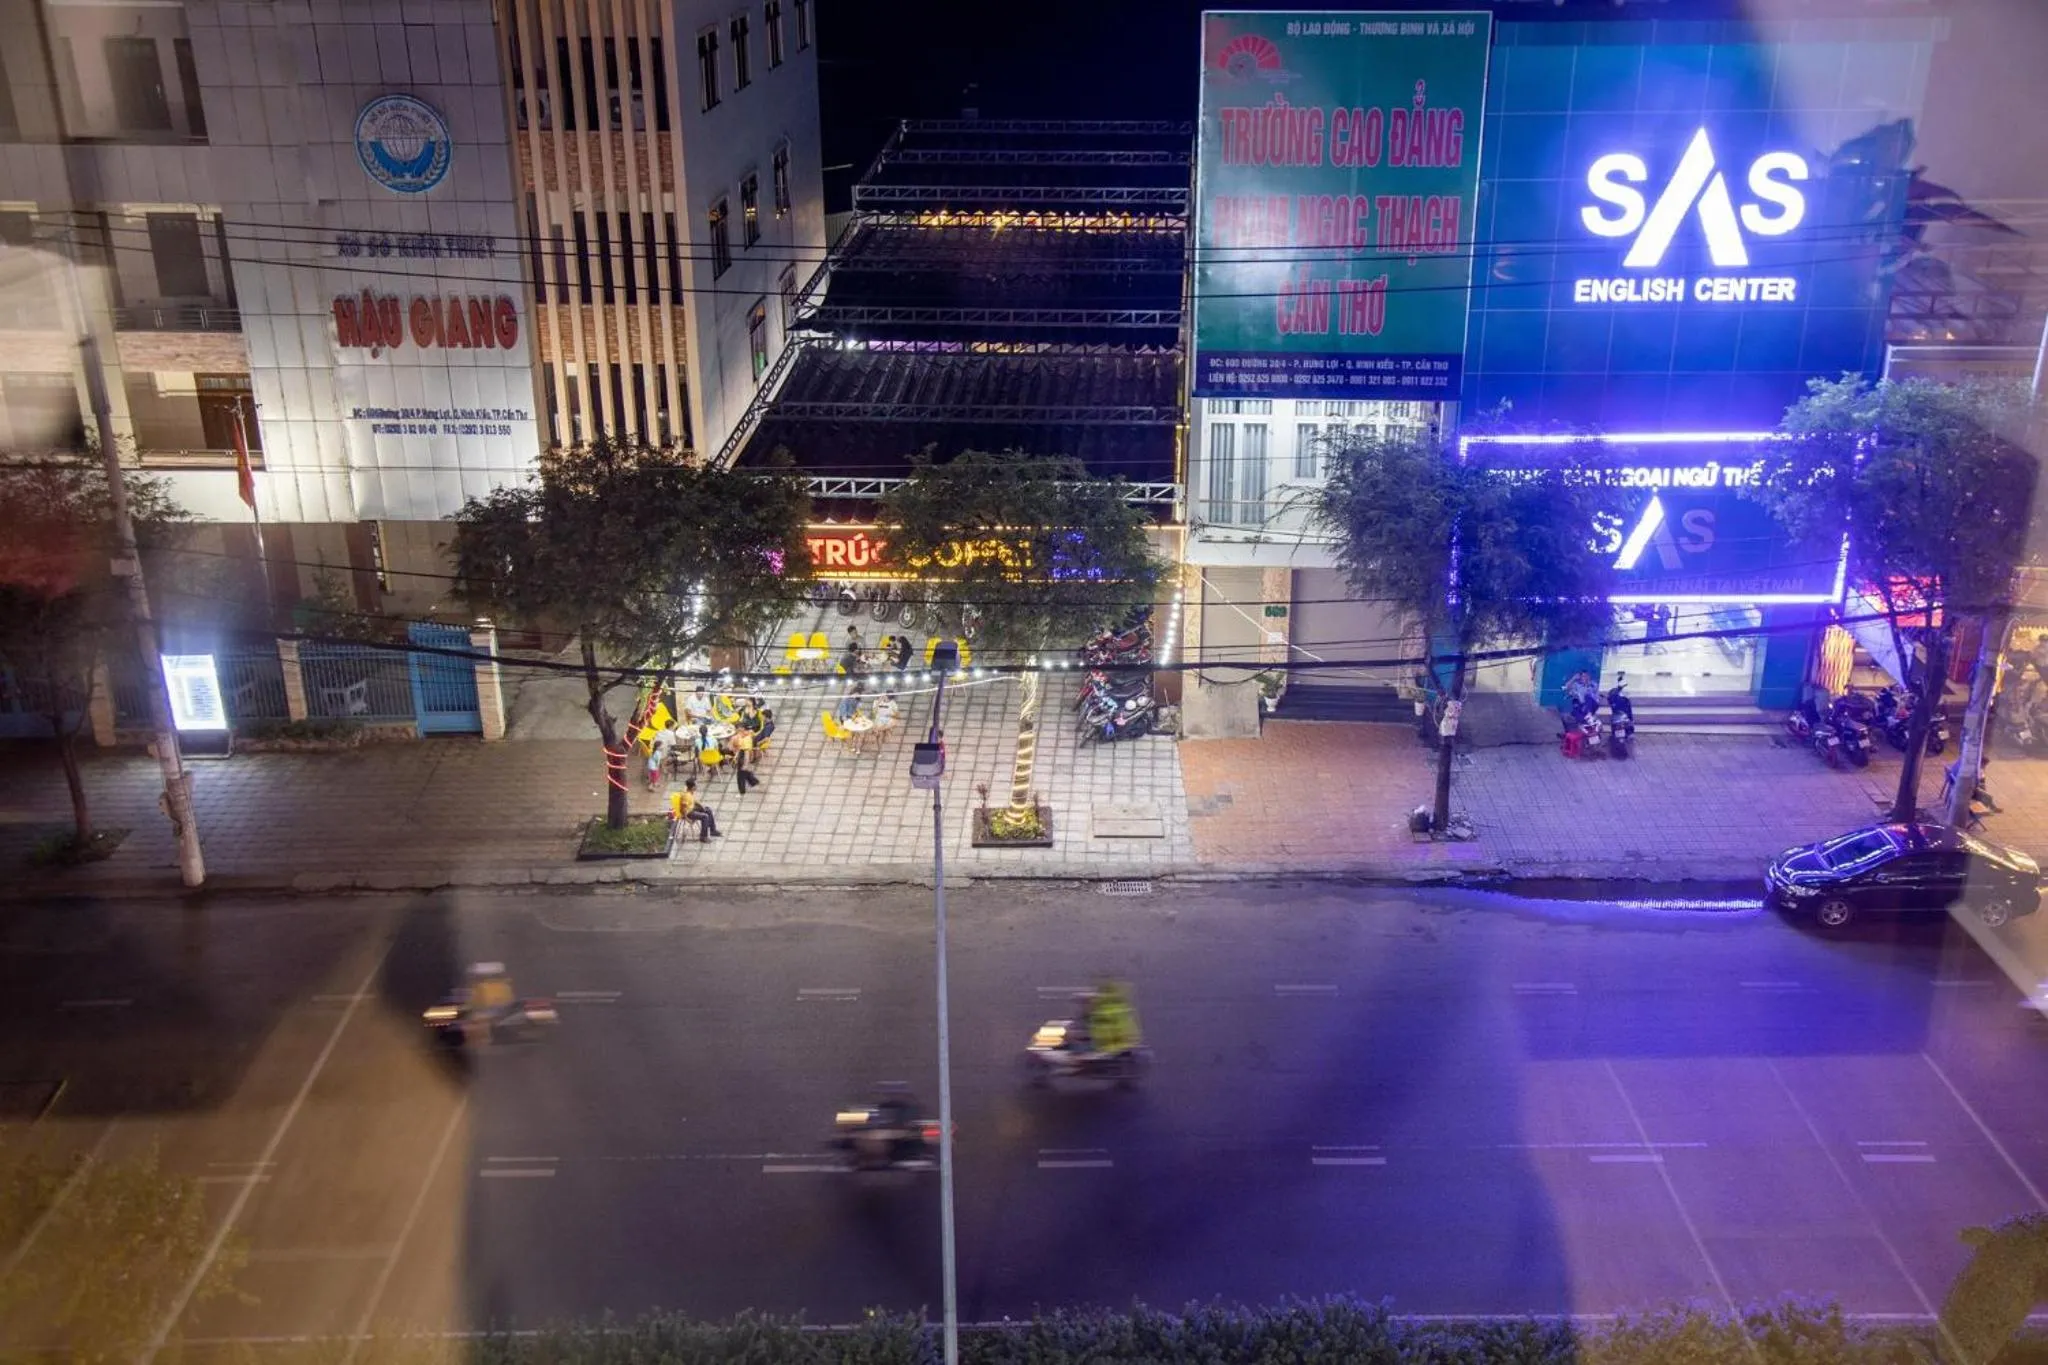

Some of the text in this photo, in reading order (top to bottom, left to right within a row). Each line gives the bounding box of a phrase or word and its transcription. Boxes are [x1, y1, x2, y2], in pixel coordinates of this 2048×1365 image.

[1219, 79, 1464, 168] TRƯỜNG CAO ĐẲNG
[1296, 195, 1368, 263] NGỌC
[1375, 195, 1461, 266] THẠCH
[1581, 126, 1809, 267] SAS
[332, 288, 518, 359] HẬU GIANG
[1275, 262, 1389, 336] CẦN THƠ
[1574, 276, 1797, 302] ENGLISH CENTER
[1605, 467, 1670, 493] NGOẠI
[1673, 460, 1721, 487] NGỮ
[1586, 495, 1717, 569] SAS
